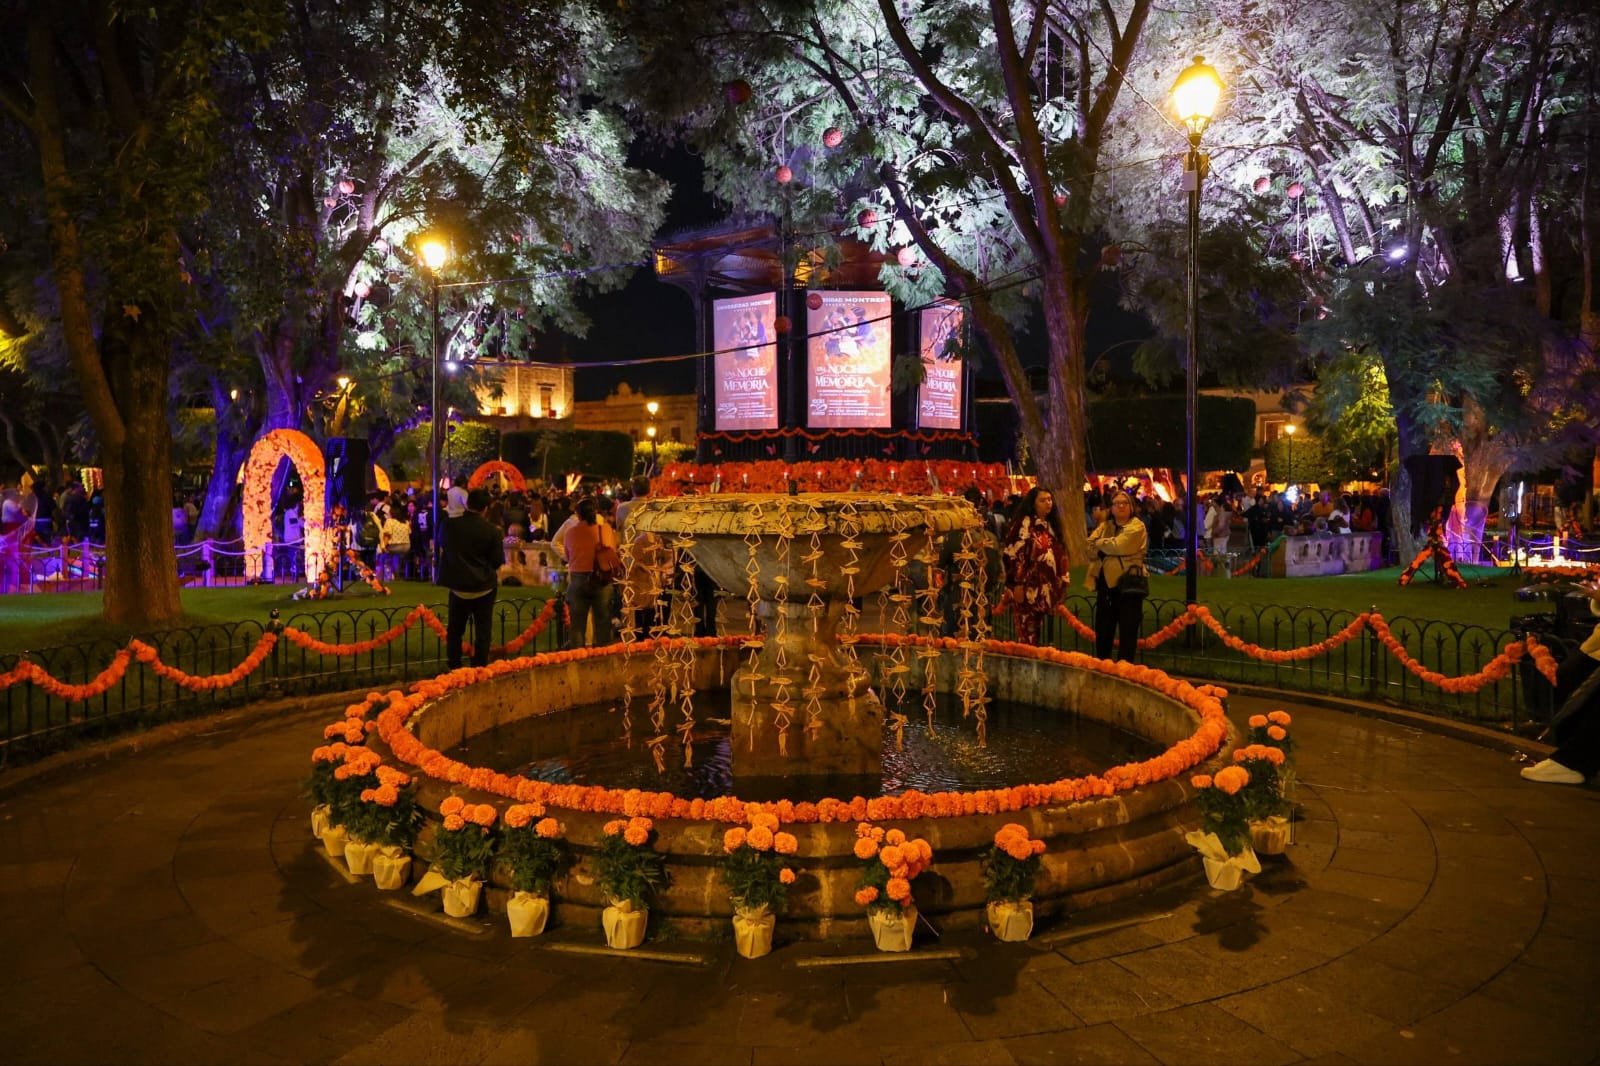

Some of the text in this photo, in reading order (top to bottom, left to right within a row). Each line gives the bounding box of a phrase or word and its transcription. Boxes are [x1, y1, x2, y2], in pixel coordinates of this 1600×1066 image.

[737, 367, 767, 377] NOCHE
[827, 364, 873, 374] NOCHE
[723, 379, 770, 392] MEMORIA
[815, 376, 880, 389] MEMORIA
[926, 379, 957, 393] MEMORIA
